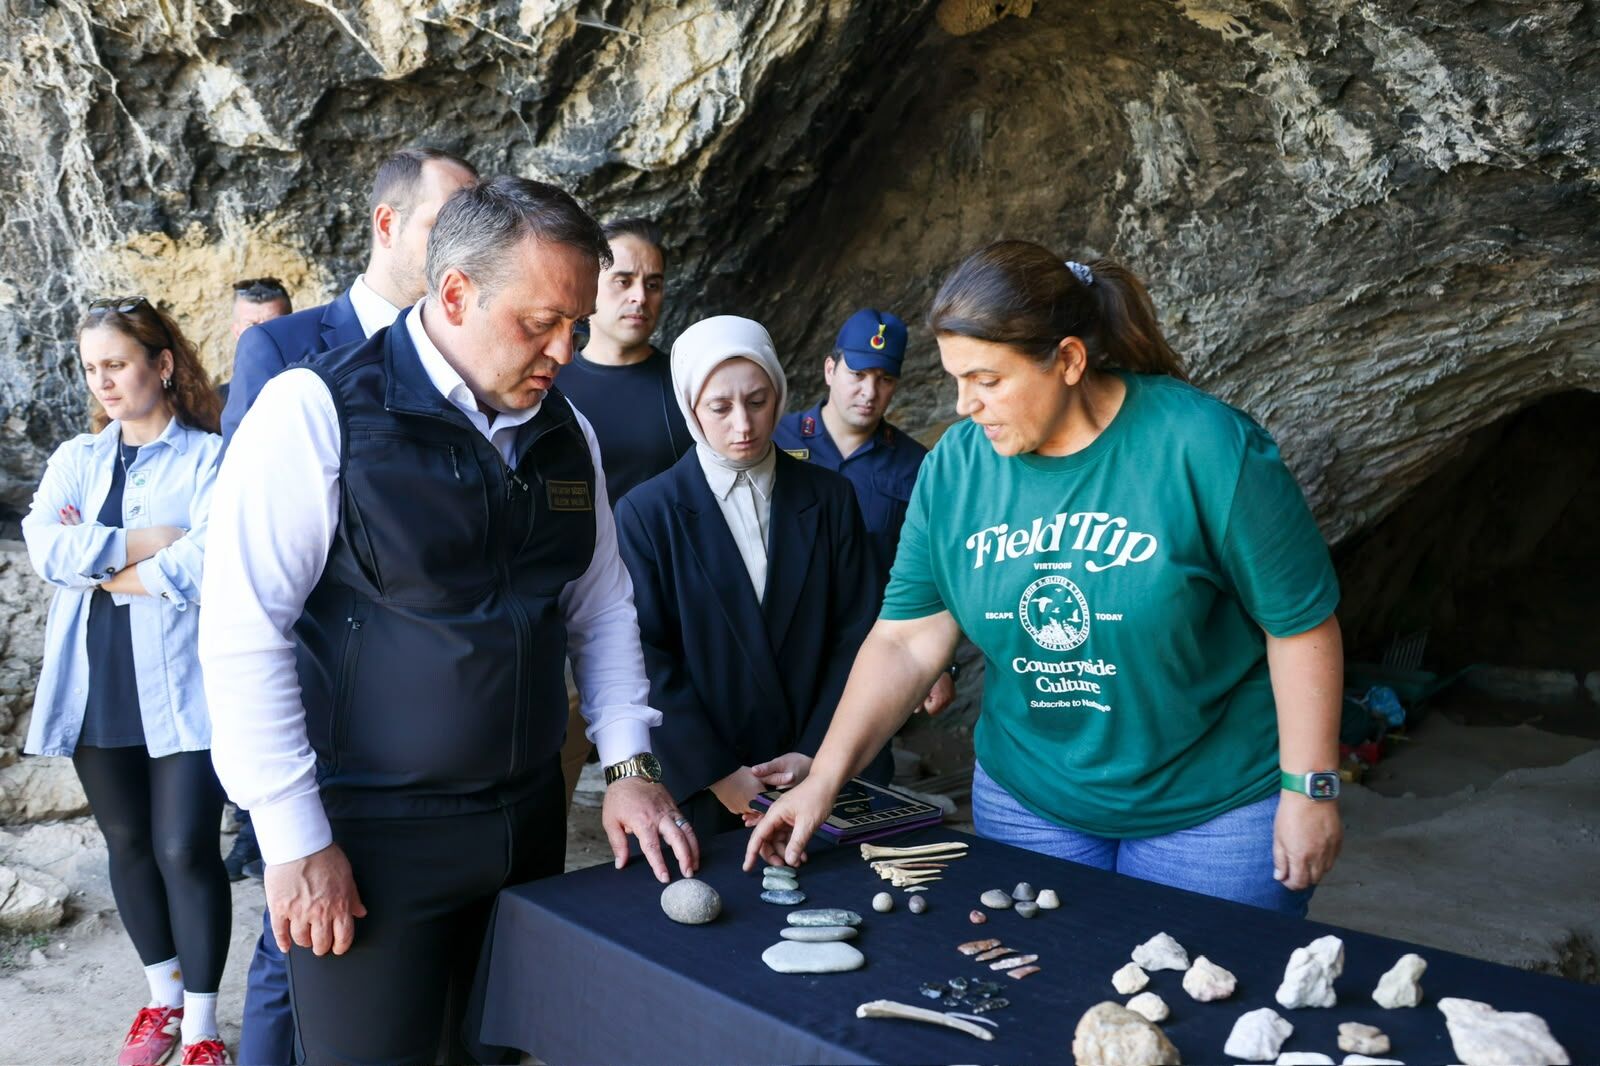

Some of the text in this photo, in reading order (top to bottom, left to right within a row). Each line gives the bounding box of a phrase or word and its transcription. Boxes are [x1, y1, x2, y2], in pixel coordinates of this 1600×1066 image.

[966, 512, 1158, 572] Field Trip
[1033, 562, 1073, 570] VIRTUOUS
[985, 612, 1015, 620] ESCAPE
[1095, 613, 1123, 621] TODAY
[1012, 657, 1117, 676] Countryside
[1035, 676, 1101, 694] Culture
[1030, 700, 1071, 708] Subscribe
[1072, 699, 1082, 707] to
